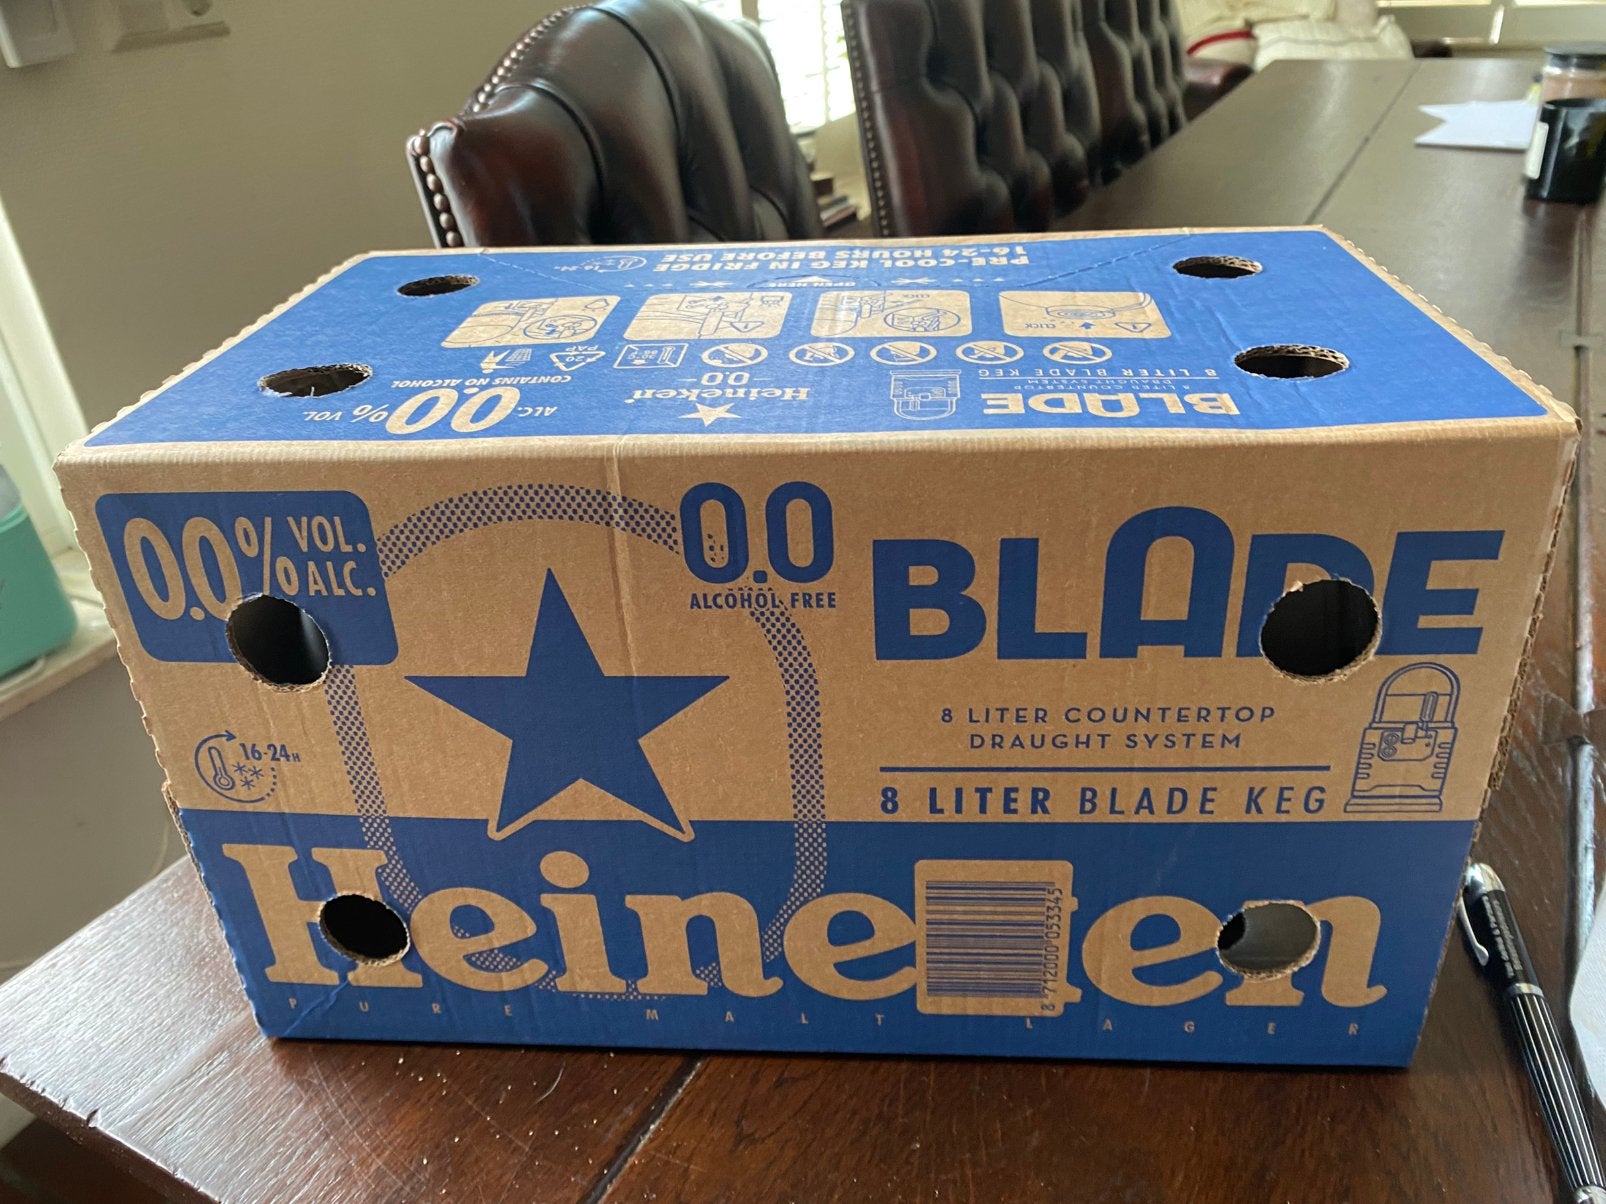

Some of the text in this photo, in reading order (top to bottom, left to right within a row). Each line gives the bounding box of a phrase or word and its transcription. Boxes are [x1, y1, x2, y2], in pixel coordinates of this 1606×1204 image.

[662, 246, 1027, 262] 16-24 HOURS BEFORE USE
[652, 256, 1030, 272] PRE-COOL KEG IN FRIDGE
[564, 344, 599, 352] PAP
[390, 374, 572, 388] CONTAINS NO ALCOHOL
[700, 371, 751, 386] 0.0
[977, 368, 1217, 378] 8 LITER BLADE KEG
[631, 386, 810, 401] Heineken
[517, 406, 557, 416] ALC.
[980, 392, 1240, 418] BLADE
[302, 410, 343, 422] VOL.
[288, 515, 367, 554] VOL.
[679, 480, 834, 585] 0.0
[307, 560, 377, 597] ALC.
[873, 506, 1505, 660] BLADE
[689, 591, 837, 610] ALCOHOL FREE
[941, 706, 1276, 724] 8 LITER COUNTERTOP
[970, 733, 1242, 749] DRAUGHT SYSTEM
[880, 786, 1328, 816] 8 LITER BLADE KEG
[1045, 887, 1063, 940] 053345
[222, 843, 1388, 1007] Heineen
[1042, 945, 1059, 994] 712000
[289, 997, 1360, 1036] PURE MALT LAGER
